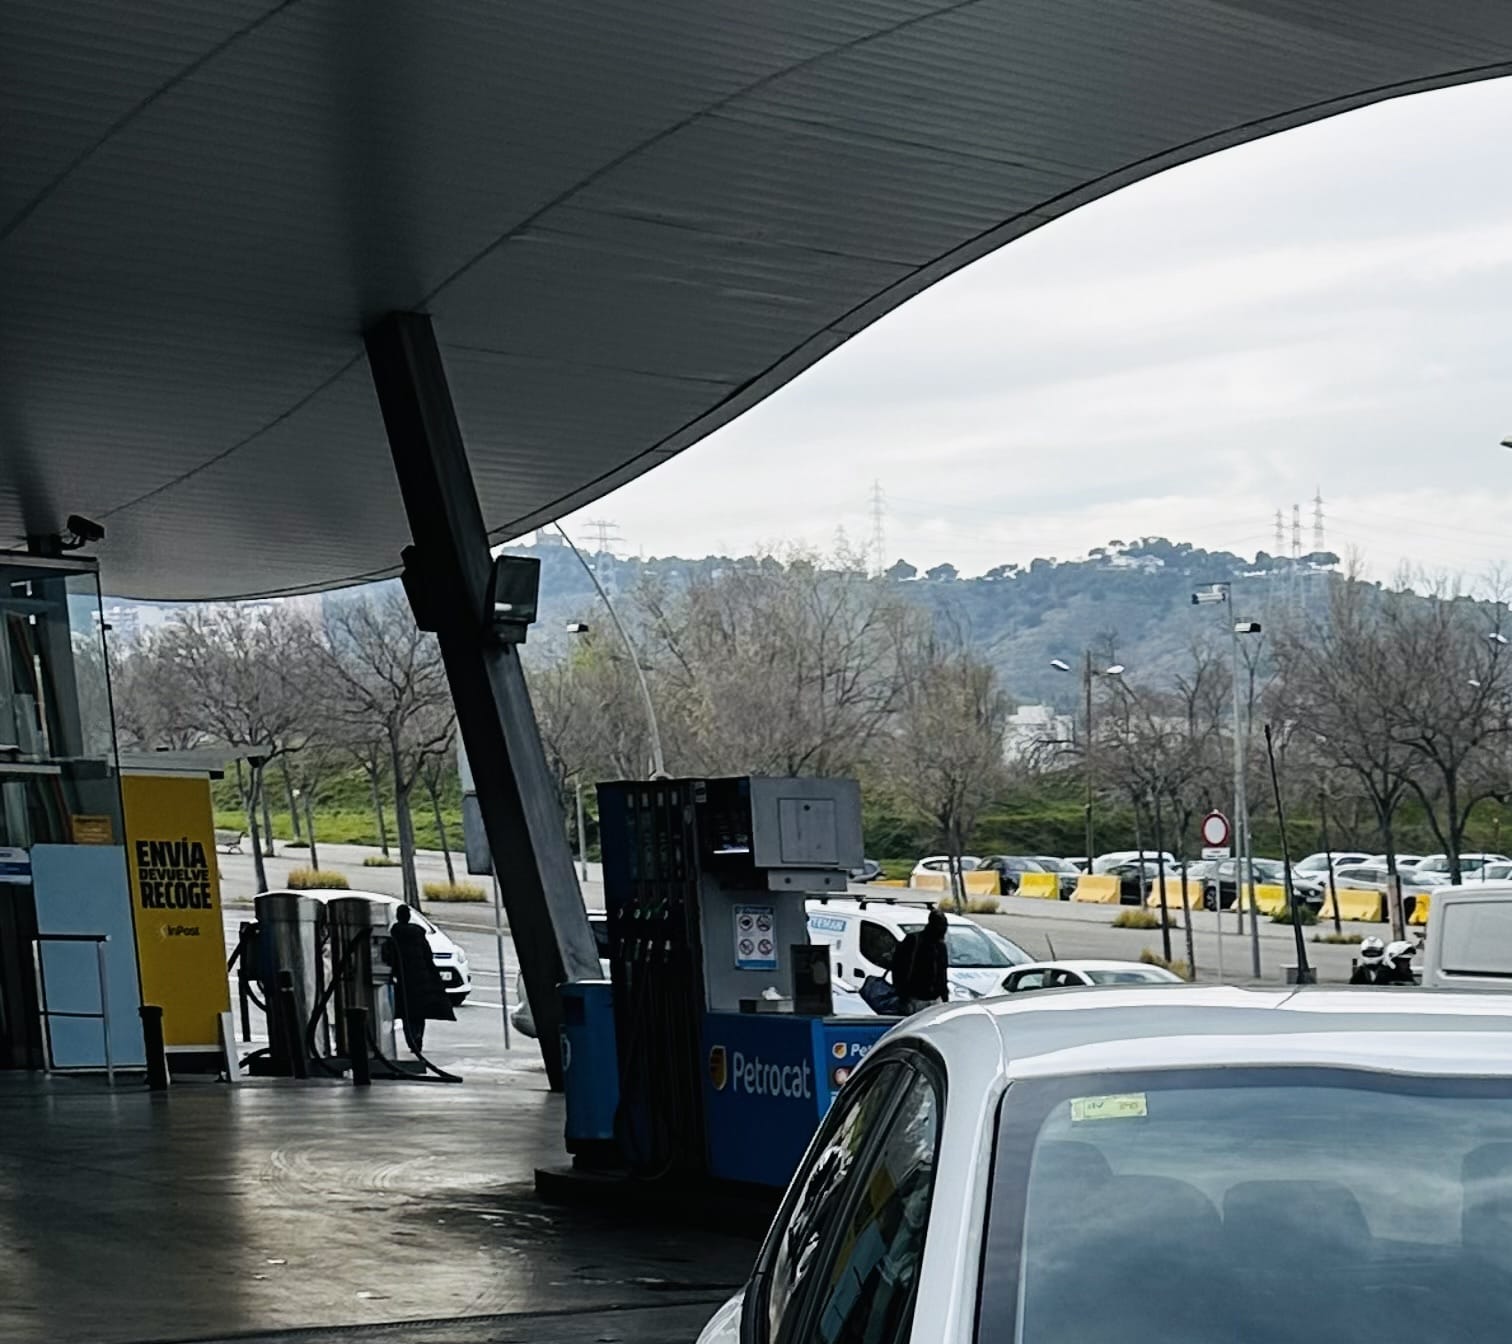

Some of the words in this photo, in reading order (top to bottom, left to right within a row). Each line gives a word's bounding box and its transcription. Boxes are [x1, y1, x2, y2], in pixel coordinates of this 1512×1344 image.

[138, 867, 209, 881] DEVUELVE
[141, 881, 213, 909] RECOGE
[733, 1052, 811, 1098] Petrocat
